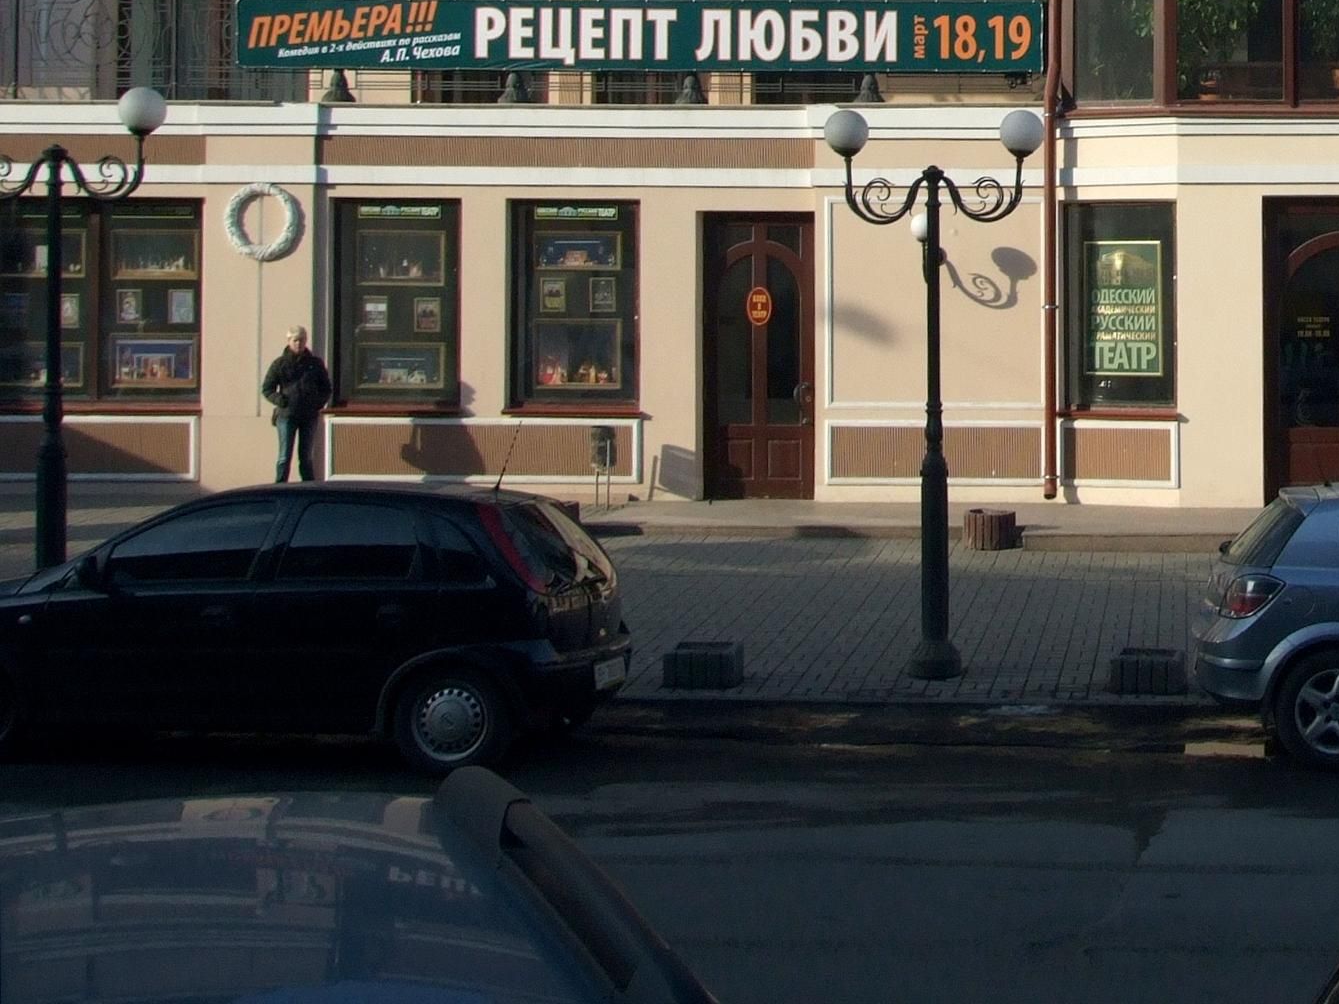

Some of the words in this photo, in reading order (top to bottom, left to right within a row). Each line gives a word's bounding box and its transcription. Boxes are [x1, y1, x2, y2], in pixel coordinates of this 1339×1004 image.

[277, 45, 320, 58] Комедия
[321, 45, 328, 54] в
[345, 38, 397, 52] действиях
[398, 37, 410, 47] по
[411, 32, 462, 47] рассказам
[474, 6, 678, 65] РЕЦЕПТ
[694, 8, 898, 62] ЛЮБВИ
[913, 14, 929, 59] март
[933, 13, 1032, 63] 18,19
[413, 44, 461, 60] Чехова
[1091, 287, 1156, 304] ОДЕССКИЙ
[1091, 315, 1156, 331] РУССКИЙ
[1091, 341, 1157, 370] ТЕАТР
